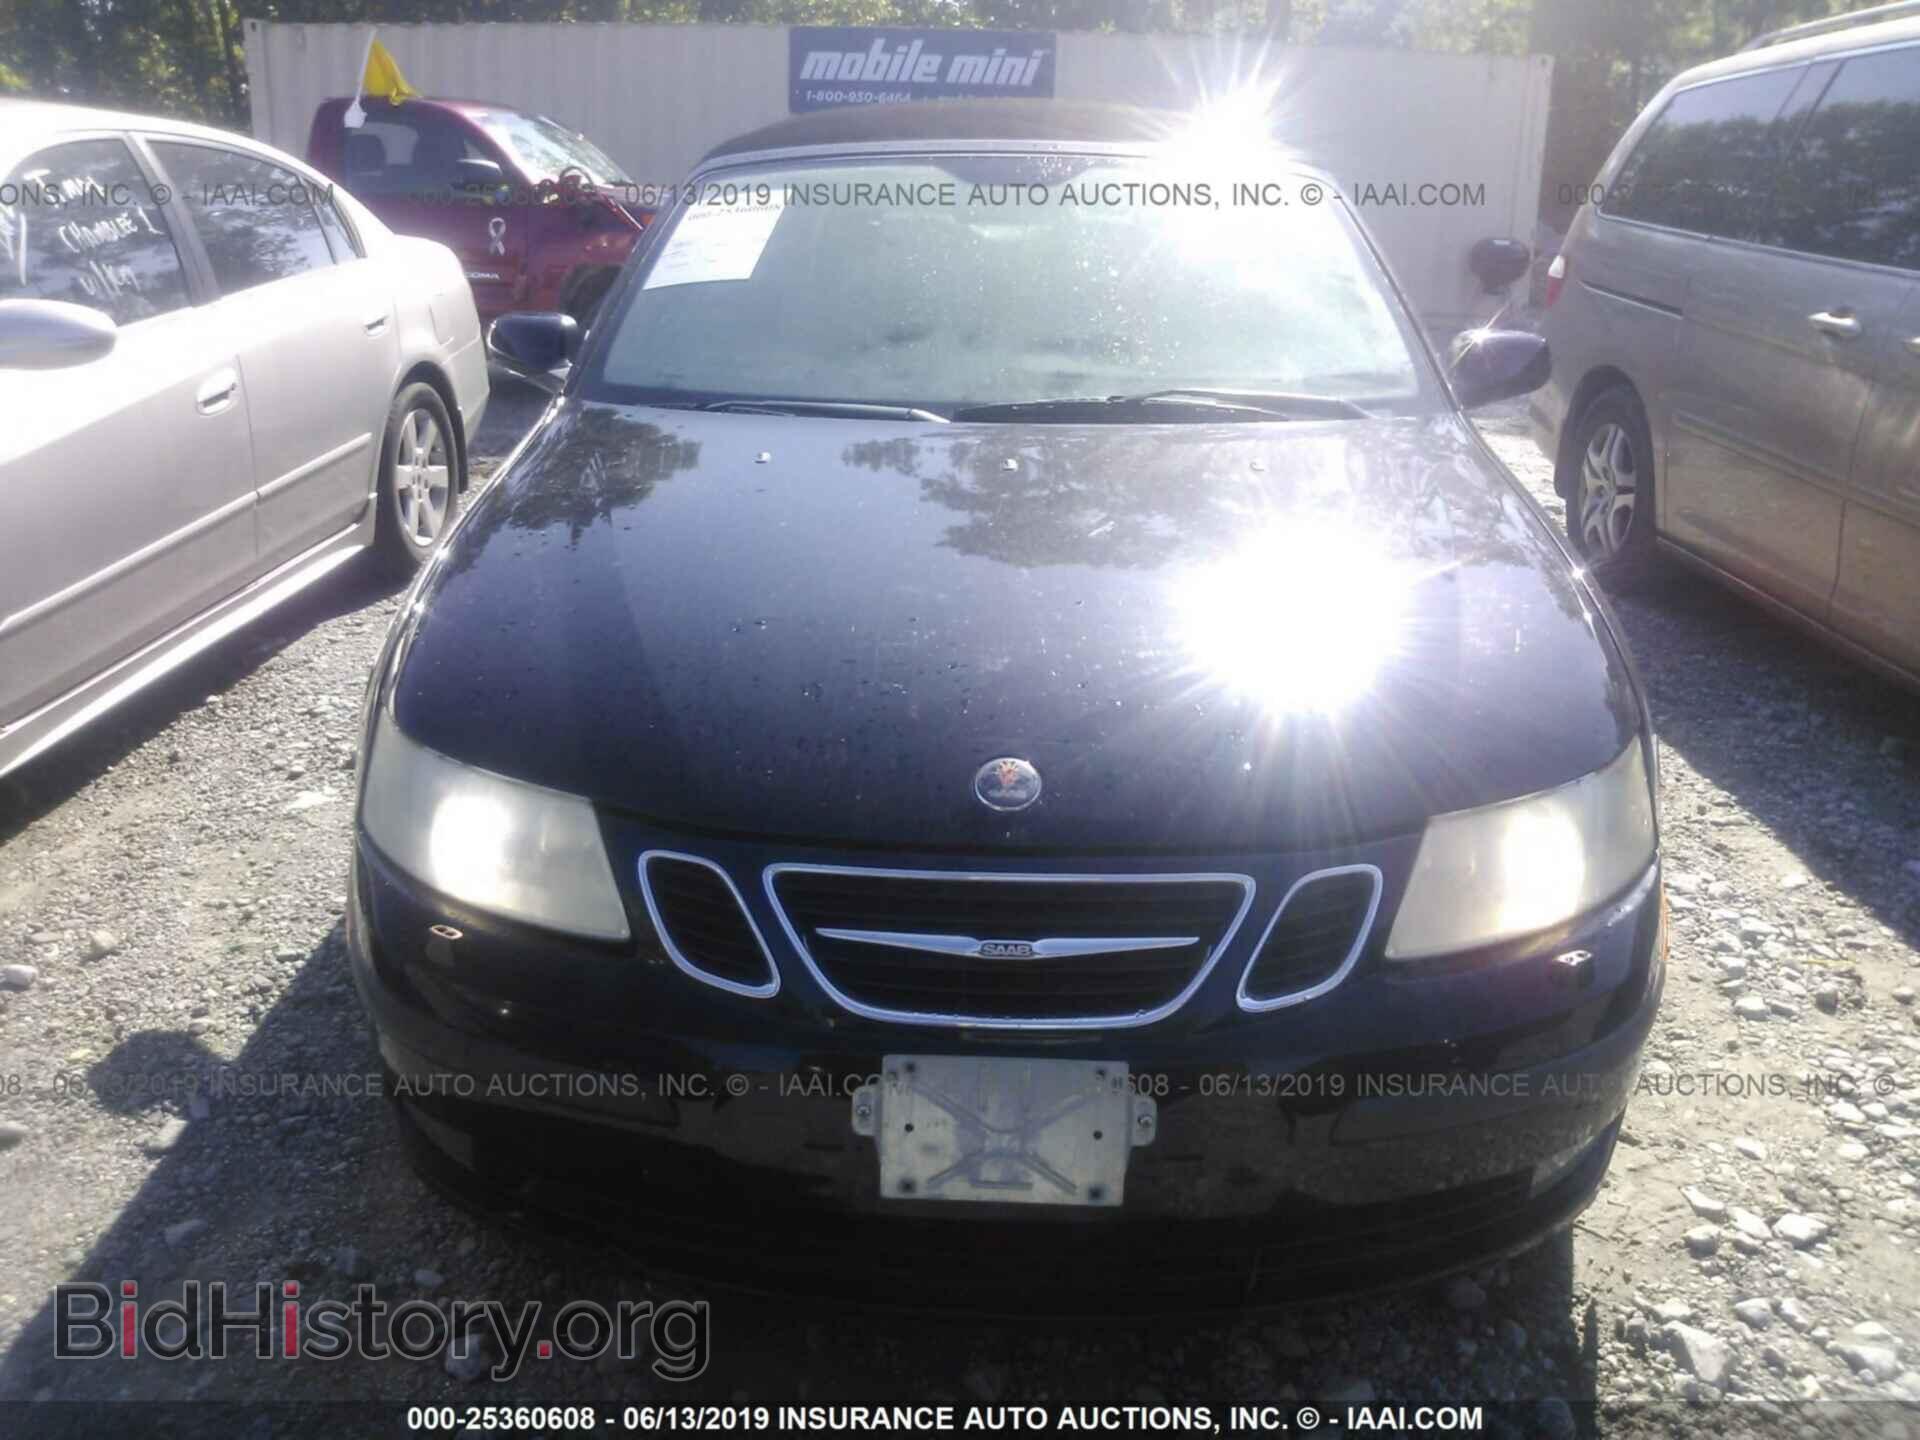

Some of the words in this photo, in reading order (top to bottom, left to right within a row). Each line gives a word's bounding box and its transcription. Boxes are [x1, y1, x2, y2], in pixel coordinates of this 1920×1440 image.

[800, 38, 943, 82] mobile
[946, 49, 1045, 86] mini
[983, 943, 1031, 956] SAAB
